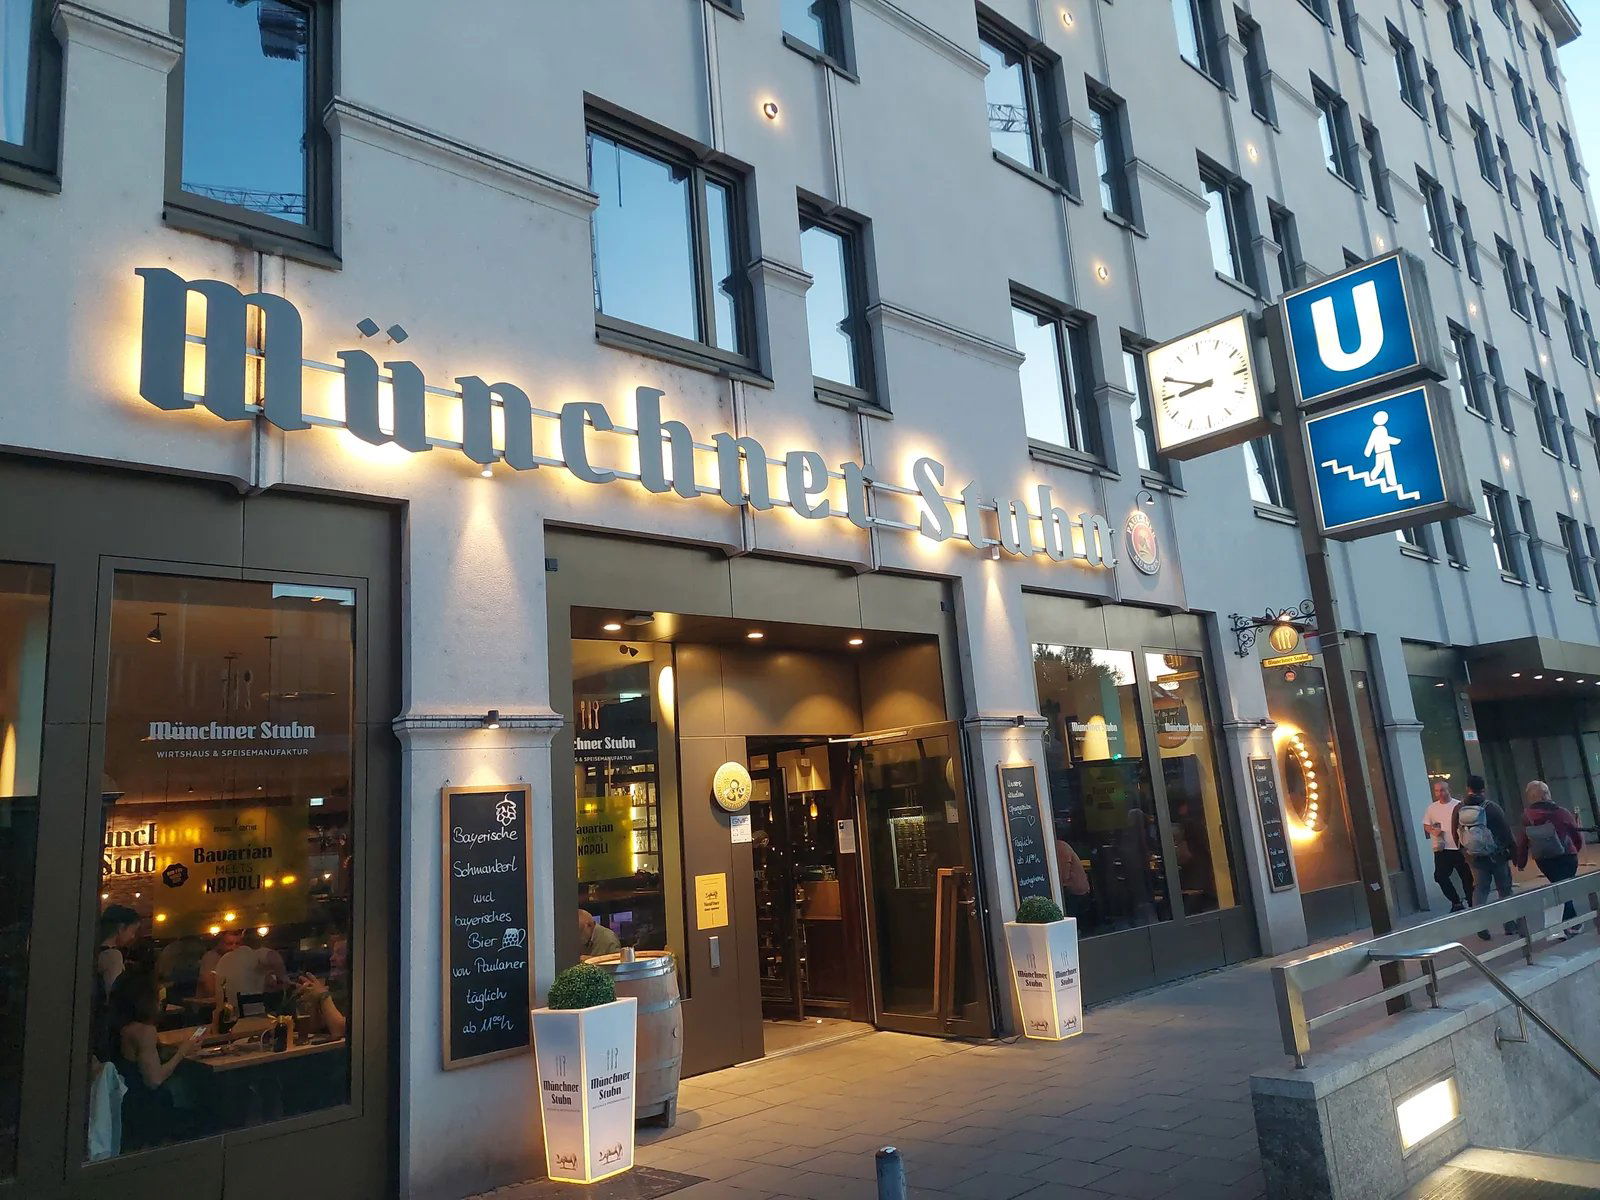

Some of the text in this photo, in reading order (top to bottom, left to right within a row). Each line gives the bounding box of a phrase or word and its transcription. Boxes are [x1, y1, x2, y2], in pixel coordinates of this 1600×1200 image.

[1310, 280, 1384, 372] U
[135, 268, 1115, 568] Münchner Stubn
[148, 721, 316, 740] Münchner Stubn
[604, 736, 636, 749] Stubn
[157, 748, 309, 758] WIRTSHAUS & SPEISEMANUFAKTUR
[576, 823, 614, 834] avarian
[453, 826, 518, 850] Bayerische
[578, 843, 608, 856] NAPOLI
[215, 864, 253, 875] MEETS
[453, 856, 518, 878] Schmankerl
[205, 874, 261, 894] NAPOLI
[472, 891, 495, 904] und
[455, 910, 512, 932] bayerisches
[467, 932, 497, 950] Bier
[452, 957, 527, 978] von Paulaner
[466, 988, 507, 1011] täglich
[462, 1020, 477, 1034] ab
[543, 1080, 579, 1093] Münchner
[590, 1070, 631, 1089] Münchner
[551, 1094, 572, 1105] Stubn
[598, 1086, 622, 1100] Stubn
